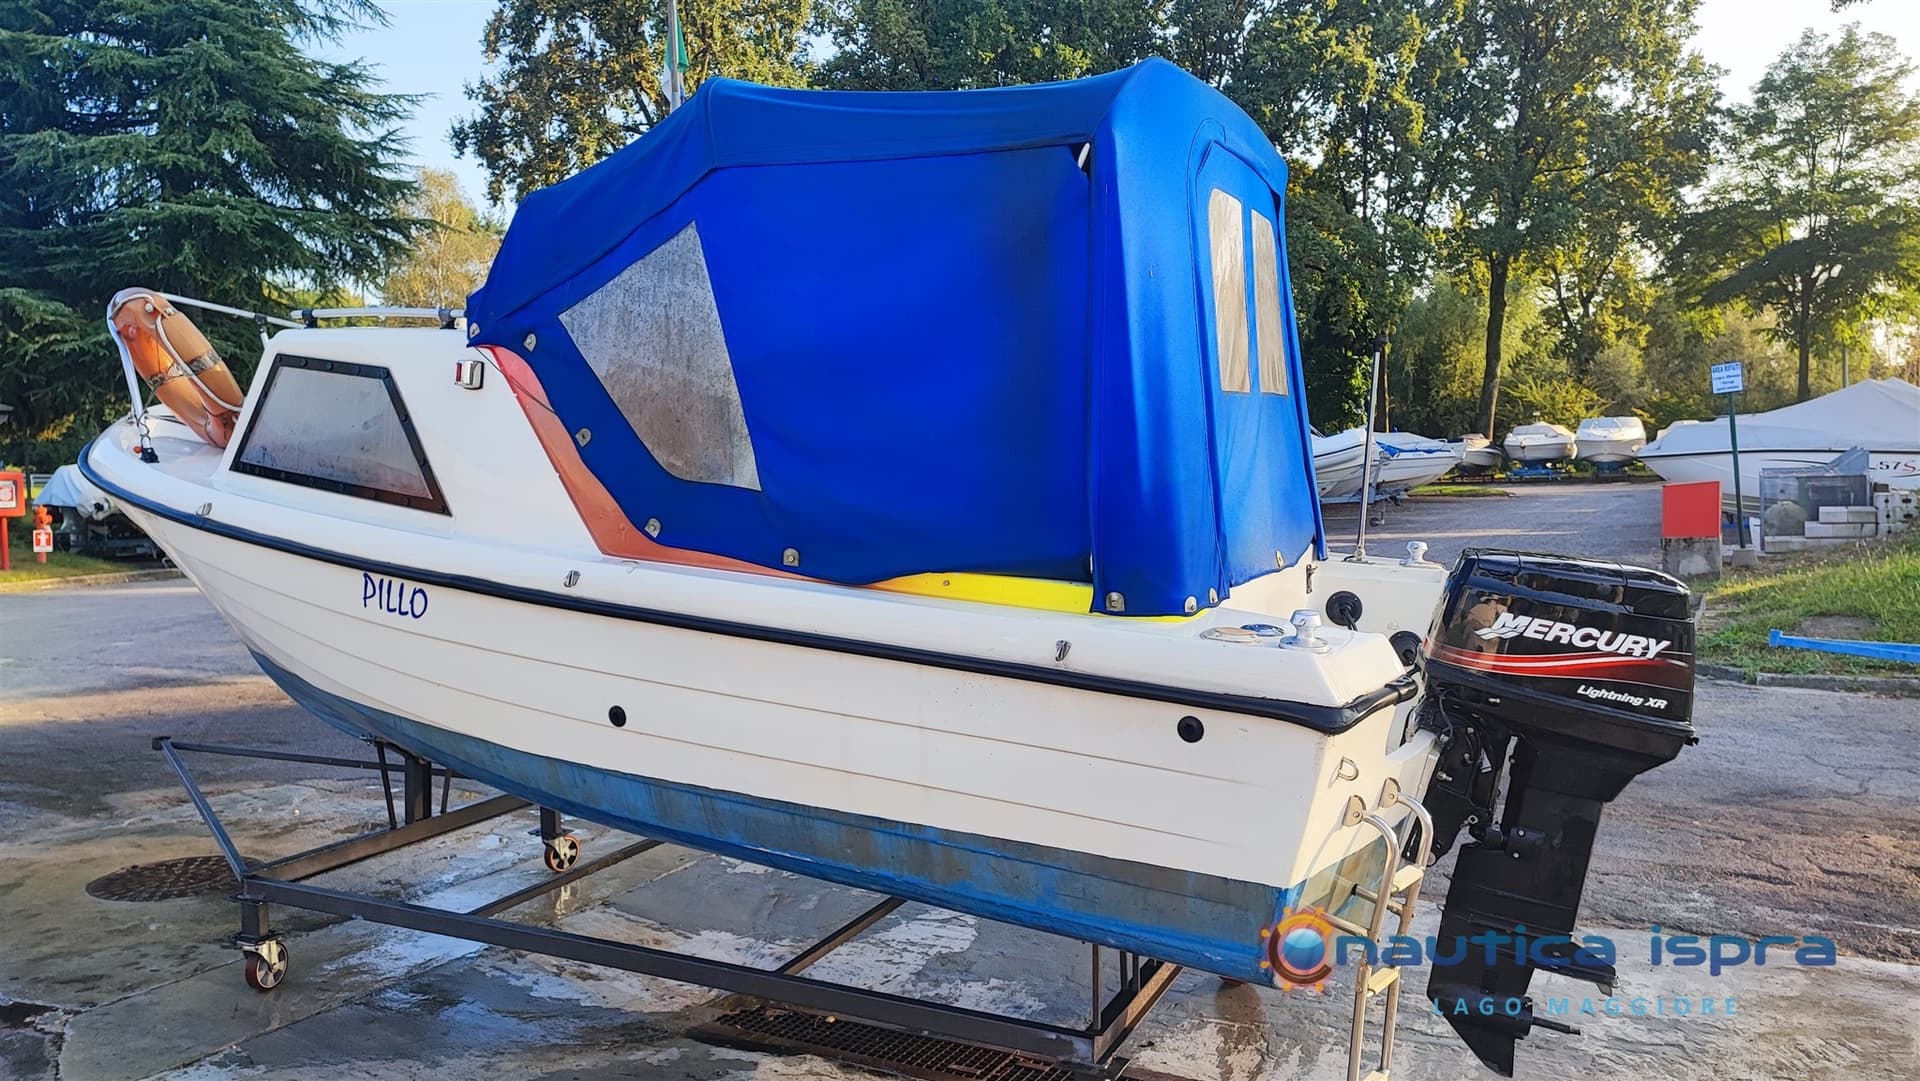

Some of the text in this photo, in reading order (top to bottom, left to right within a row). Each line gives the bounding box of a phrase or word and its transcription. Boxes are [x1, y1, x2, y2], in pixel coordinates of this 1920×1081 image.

[363, 572, 428, 619] PILLO
[1475, 612, 1671, 660] MERCURY
[1577, 684, 1668, 709] Lightning XR
